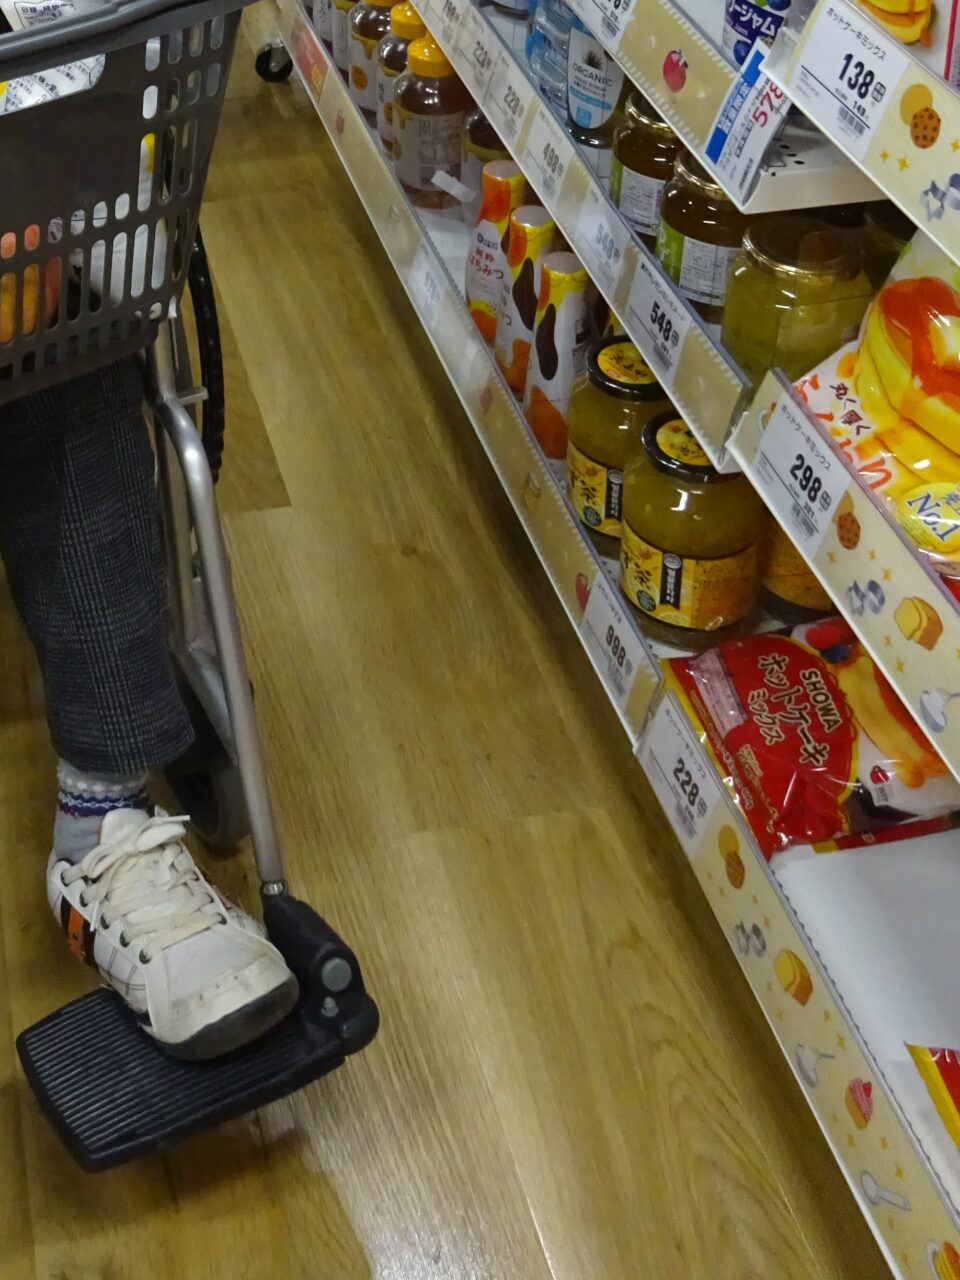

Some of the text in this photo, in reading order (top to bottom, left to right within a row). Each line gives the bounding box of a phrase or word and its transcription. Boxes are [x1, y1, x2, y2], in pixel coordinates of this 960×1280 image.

[826, 7, 887, 60] ホットケーキミックス
[572, 62, 613, 88] ORGANIC
[838, 53, 875, 99] 138
[503, 85, 520, 113] 228
[752, 81, 783, 128] 578
[852, 101, 866, 117] 149
[543, 143, 559, 169] 498
[650, 300, 672, 342] 548
[780, 403, 831, 472] ホットケーキミックス
[789, 453, 822, 504] 298
[803, 501, 816, 519] 321
[906, 491, 959, 543] No.1
[606, 624, 627, 668] 998
[747, 687, 786, 746] ミックス
[758, 652, 830, 767] ホットケーキ
[799, 667, 843, 733] SHOWA
[673, 757, 700, 808] 228
